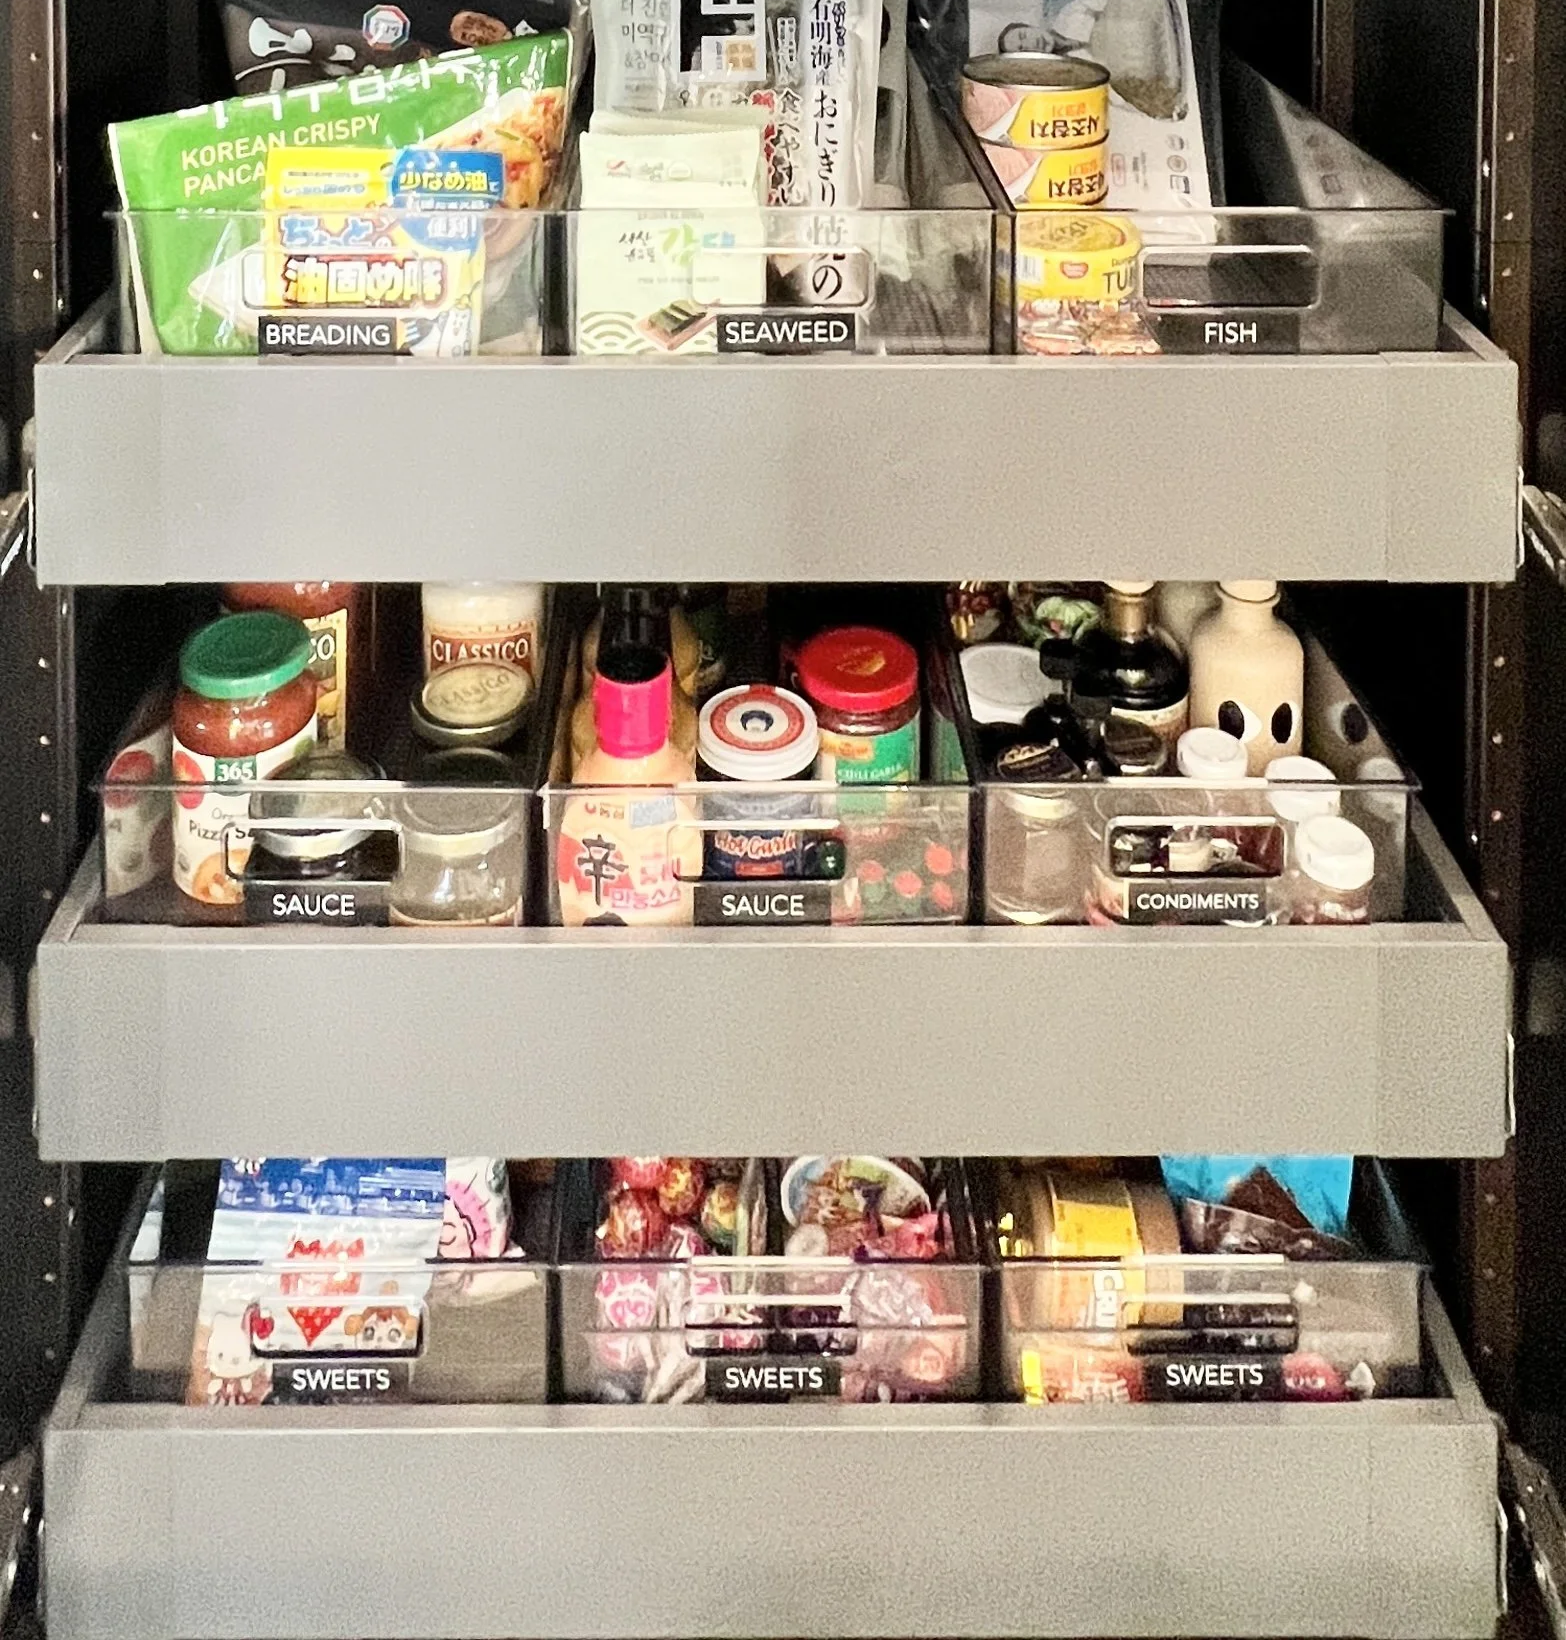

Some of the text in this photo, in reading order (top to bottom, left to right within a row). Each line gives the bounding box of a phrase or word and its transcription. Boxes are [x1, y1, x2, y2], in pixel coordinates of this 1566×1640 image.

[181, 112, 381, 171] KOREAN CRISPY
[183, 160, 267, 200] PANCA
[266, 323, 391, 346] BREADING
[725, 320, 849, 344] SEAWEED
[1204, 322, 1257, 344] FISH
[432, 637, 530, 663] CLASSICO
[217, 762, 254, 781] 365
[189, 819, 222, 842] Pizz
[577, 834, 630, 906] 辛
[273, 893, 355, 917] SAUCE
[722, 893, 805, 916] SAUCE
[1136, 893, 1260, 910] CONDIMENTS
[292, 1368, 391, 1391] SWEETS
[725, 1366, 823, 1389] SWEETS
[1166, 1363, 1264, 1387] SWEETS
